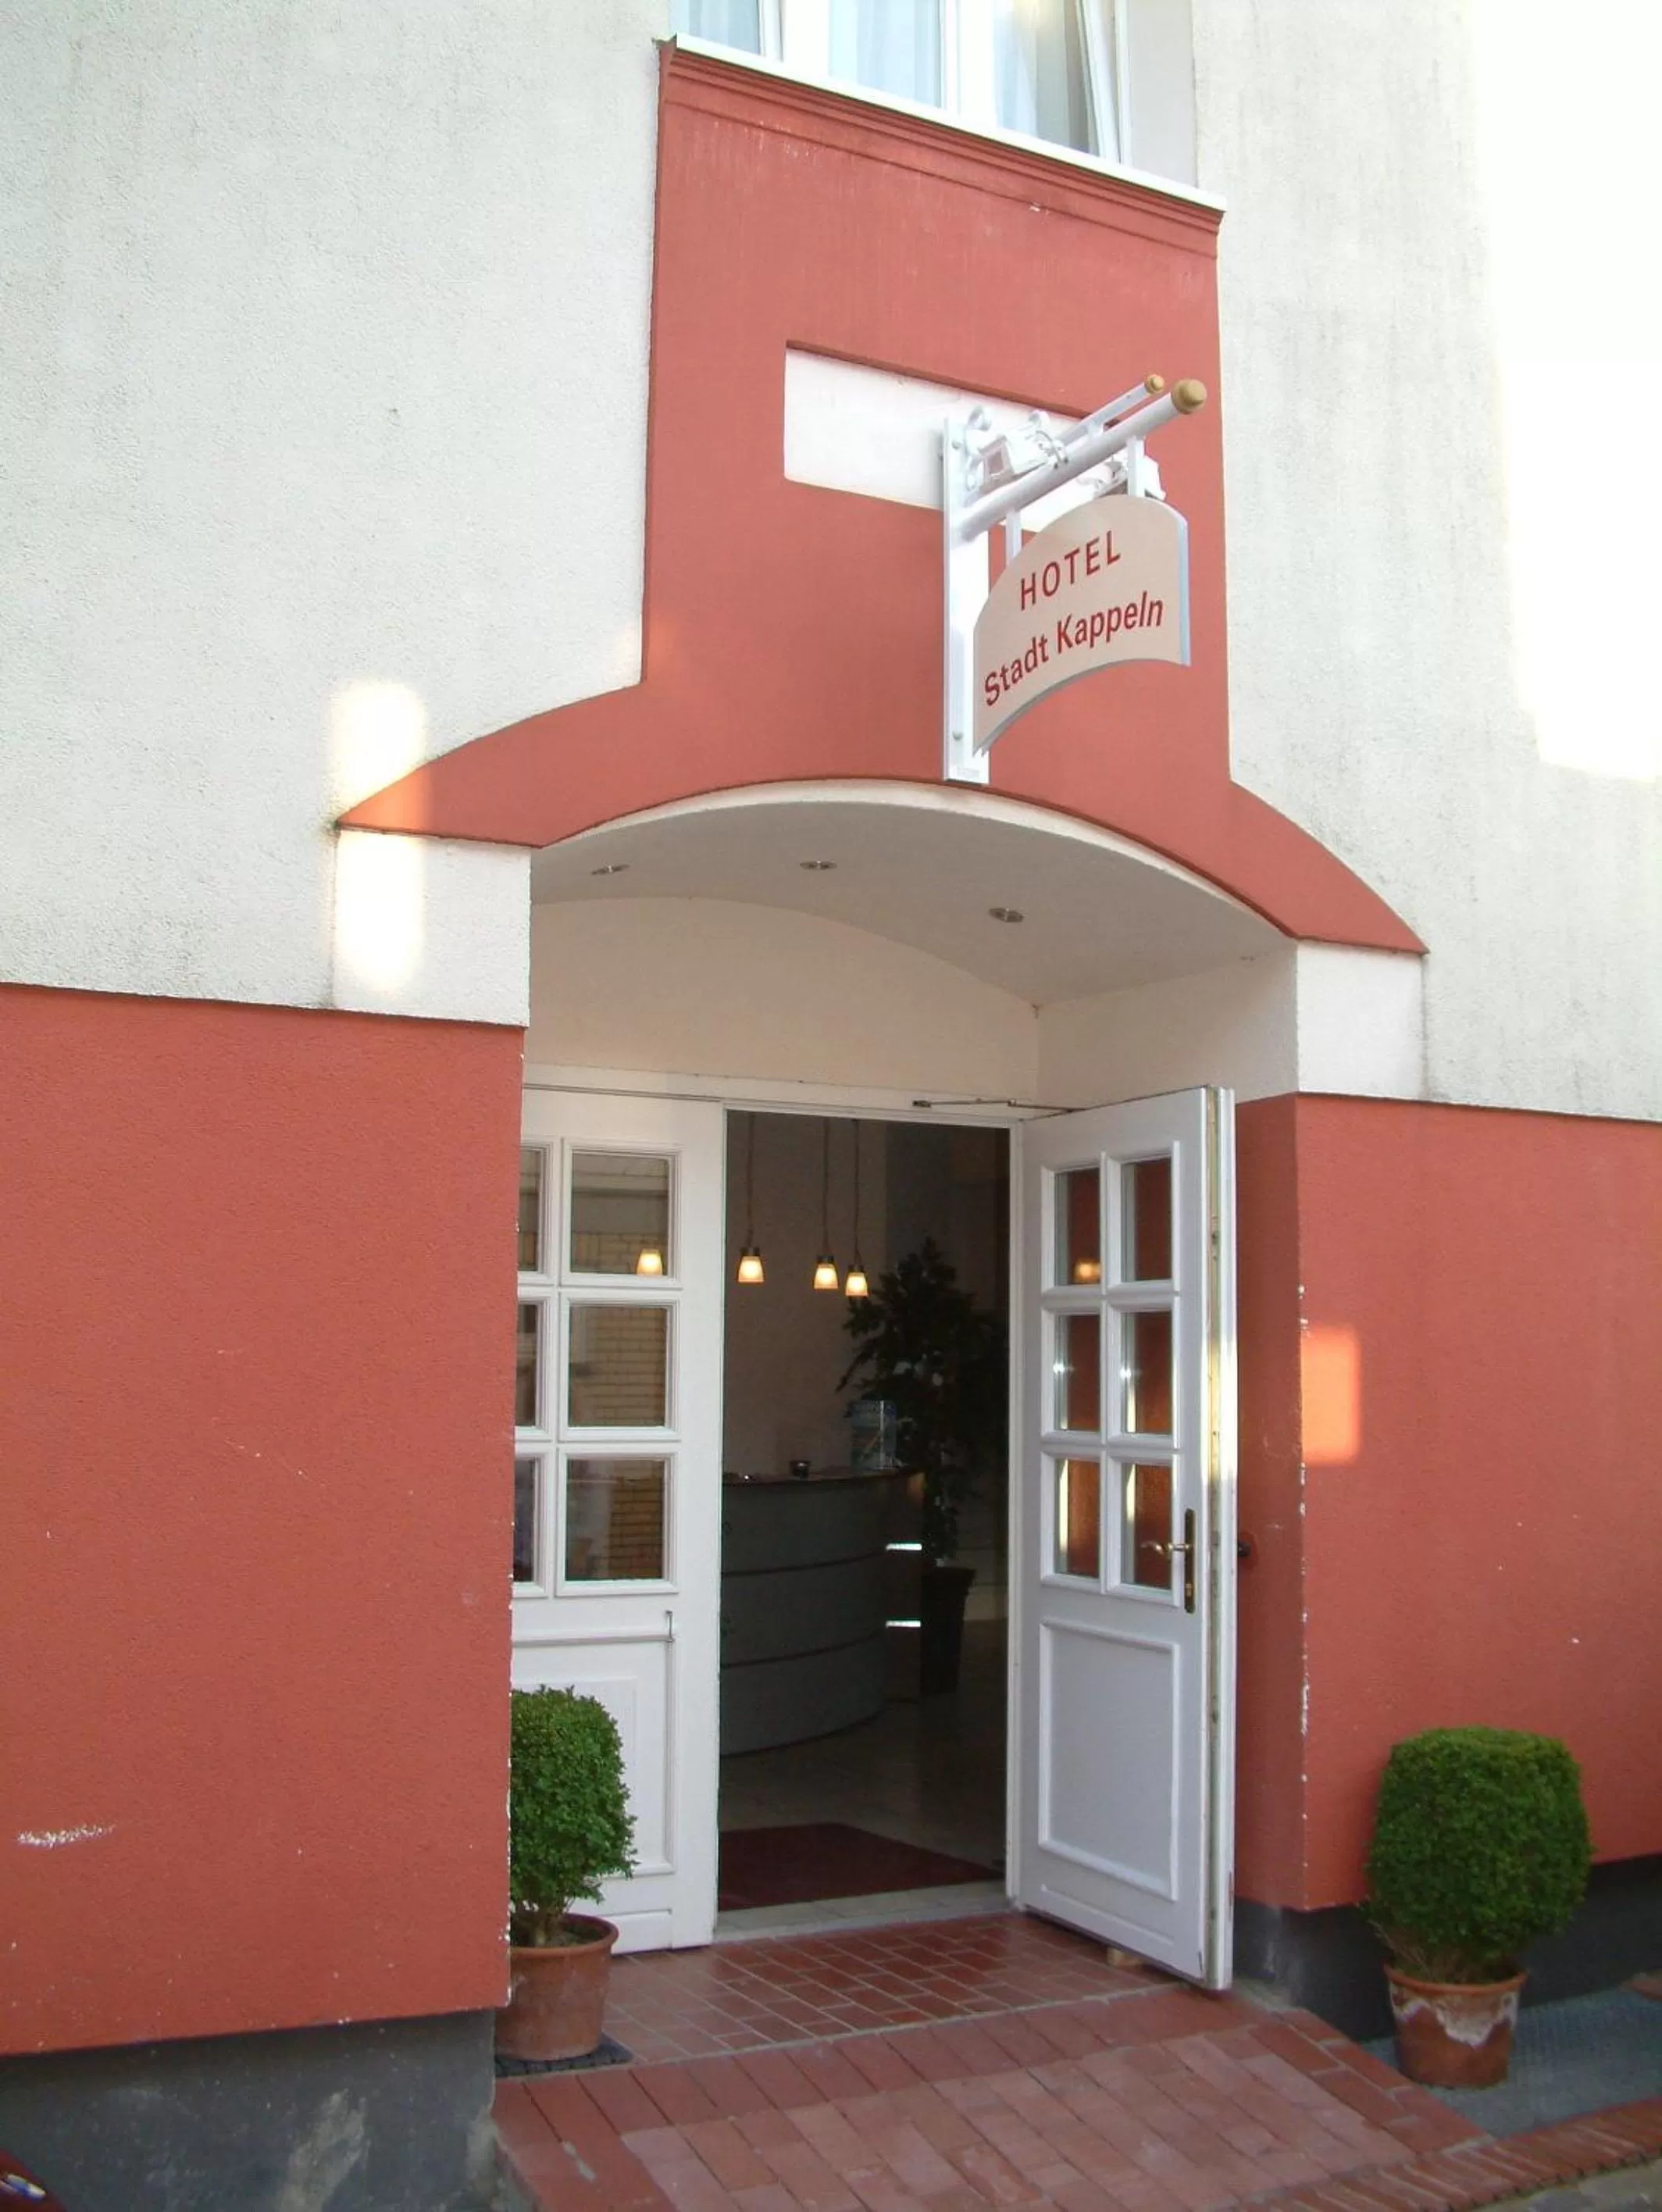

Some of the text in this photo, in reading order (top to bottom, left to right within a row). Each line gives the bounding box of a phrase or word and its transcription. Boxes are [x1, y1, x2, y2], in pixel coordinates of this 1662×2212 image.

[1020, 530, 1121, 611] HOTEL
[984, 590, 1164, 706] Stadt Kappeln
